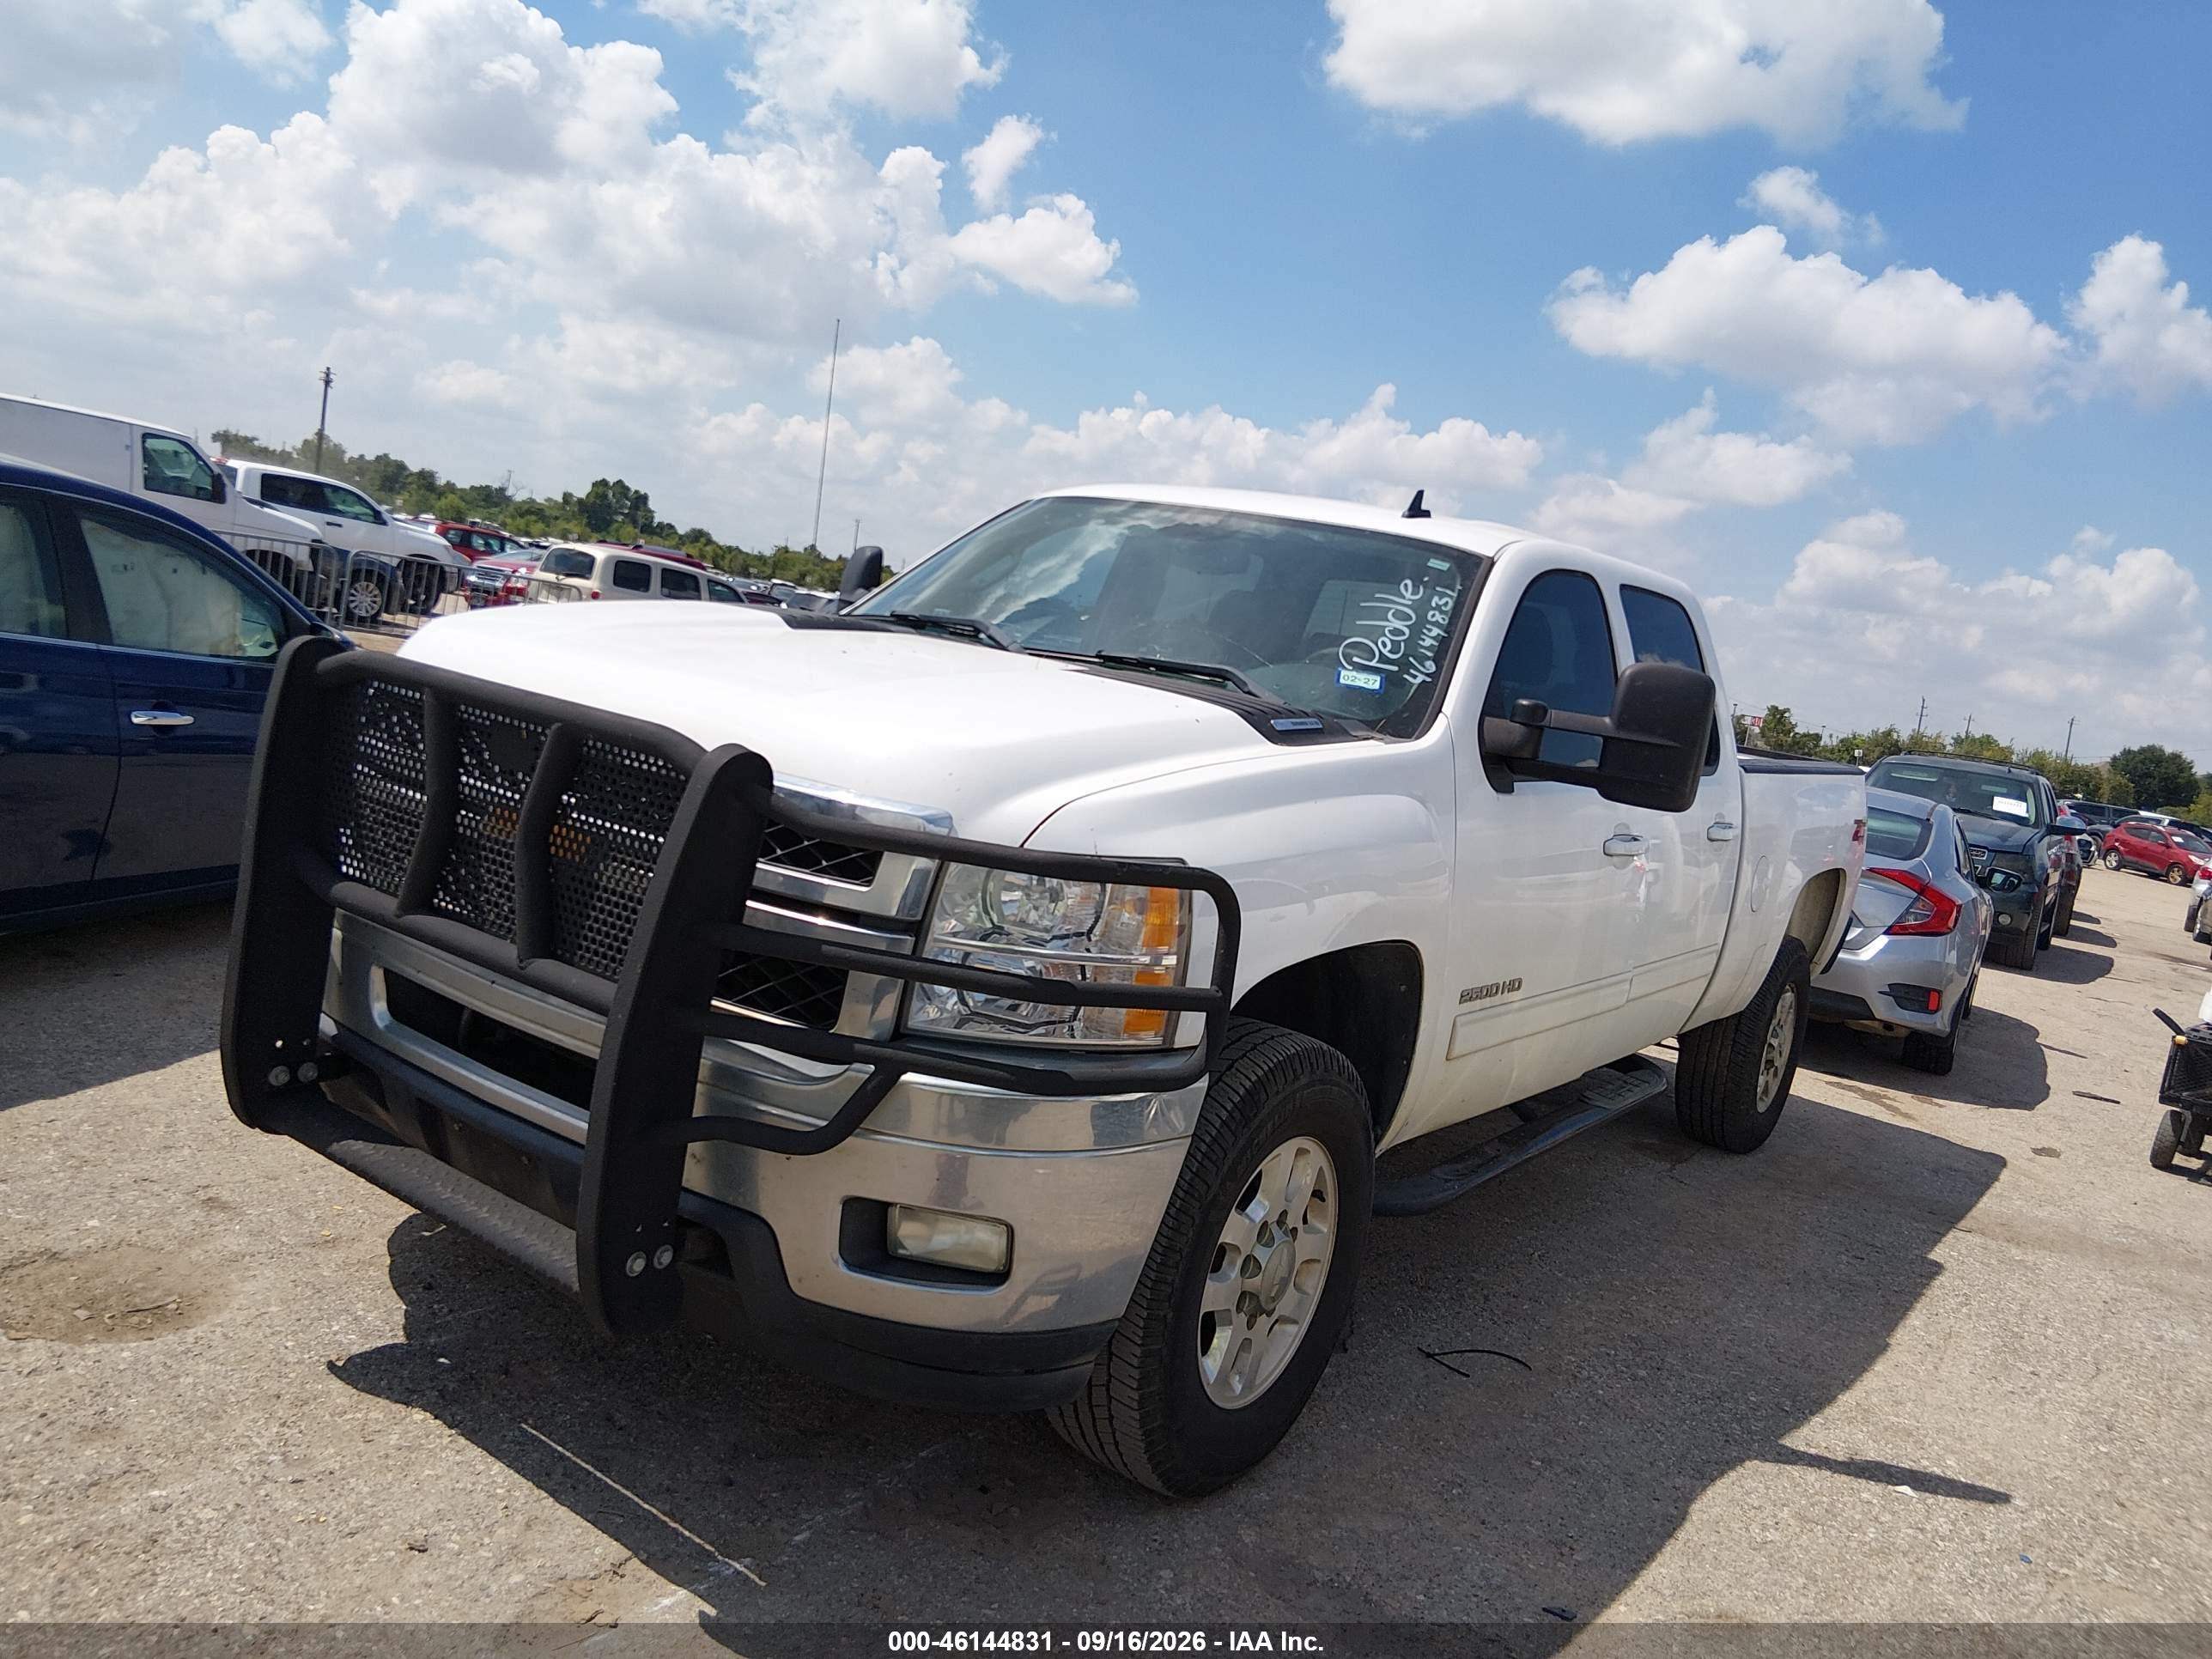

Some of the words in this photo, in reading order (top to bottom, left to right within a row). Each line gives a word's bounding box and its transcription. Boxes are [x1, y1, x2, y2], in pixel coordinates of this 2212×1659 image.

[1342, 673, 1378, 686] 02-27
[1458, 981, 1500, 1005] 2500
[1500, 977, 1522, 995] HD
